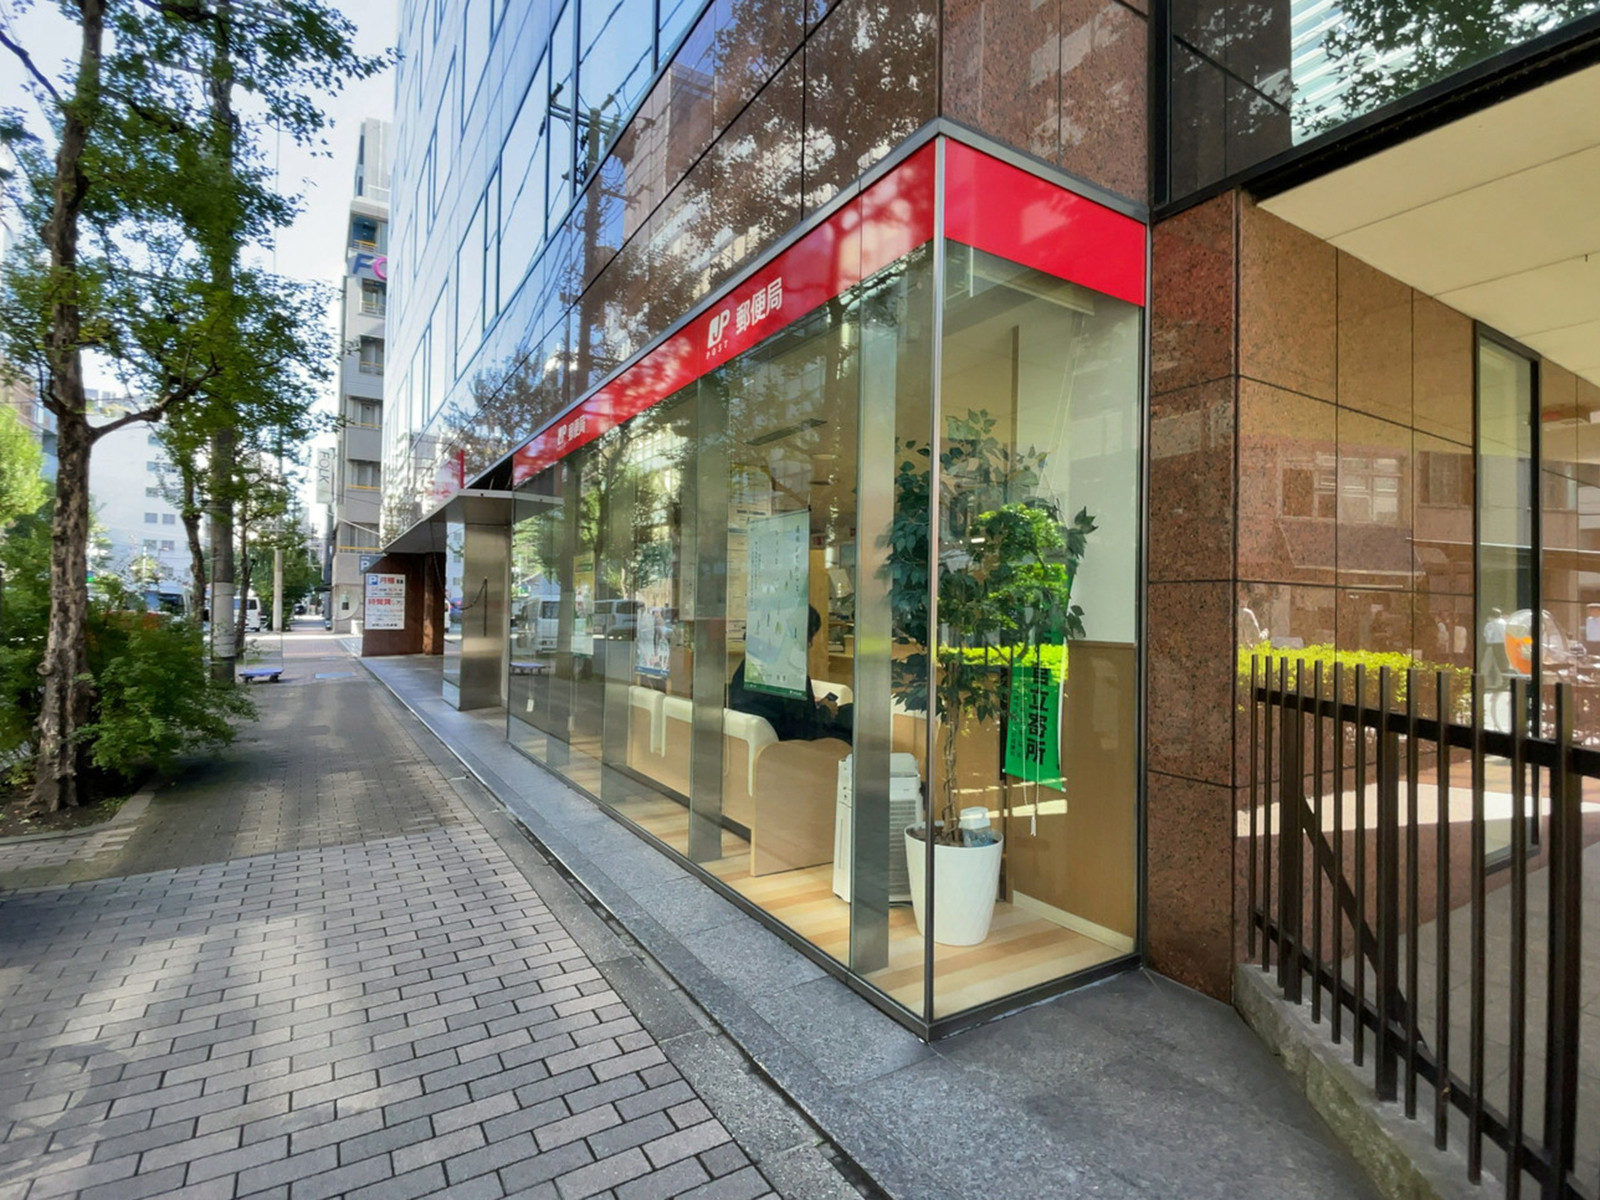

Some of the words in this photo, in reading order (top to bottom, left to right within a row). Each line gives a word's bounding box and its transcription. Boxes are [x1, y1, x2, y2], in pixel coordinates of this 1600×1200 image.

[707, 309, 730, 349] JP
[736, 277, 782, 335] 郵便局
[706, 340, 728, 360] POST
[319, 451, 330, 484] FOLK
